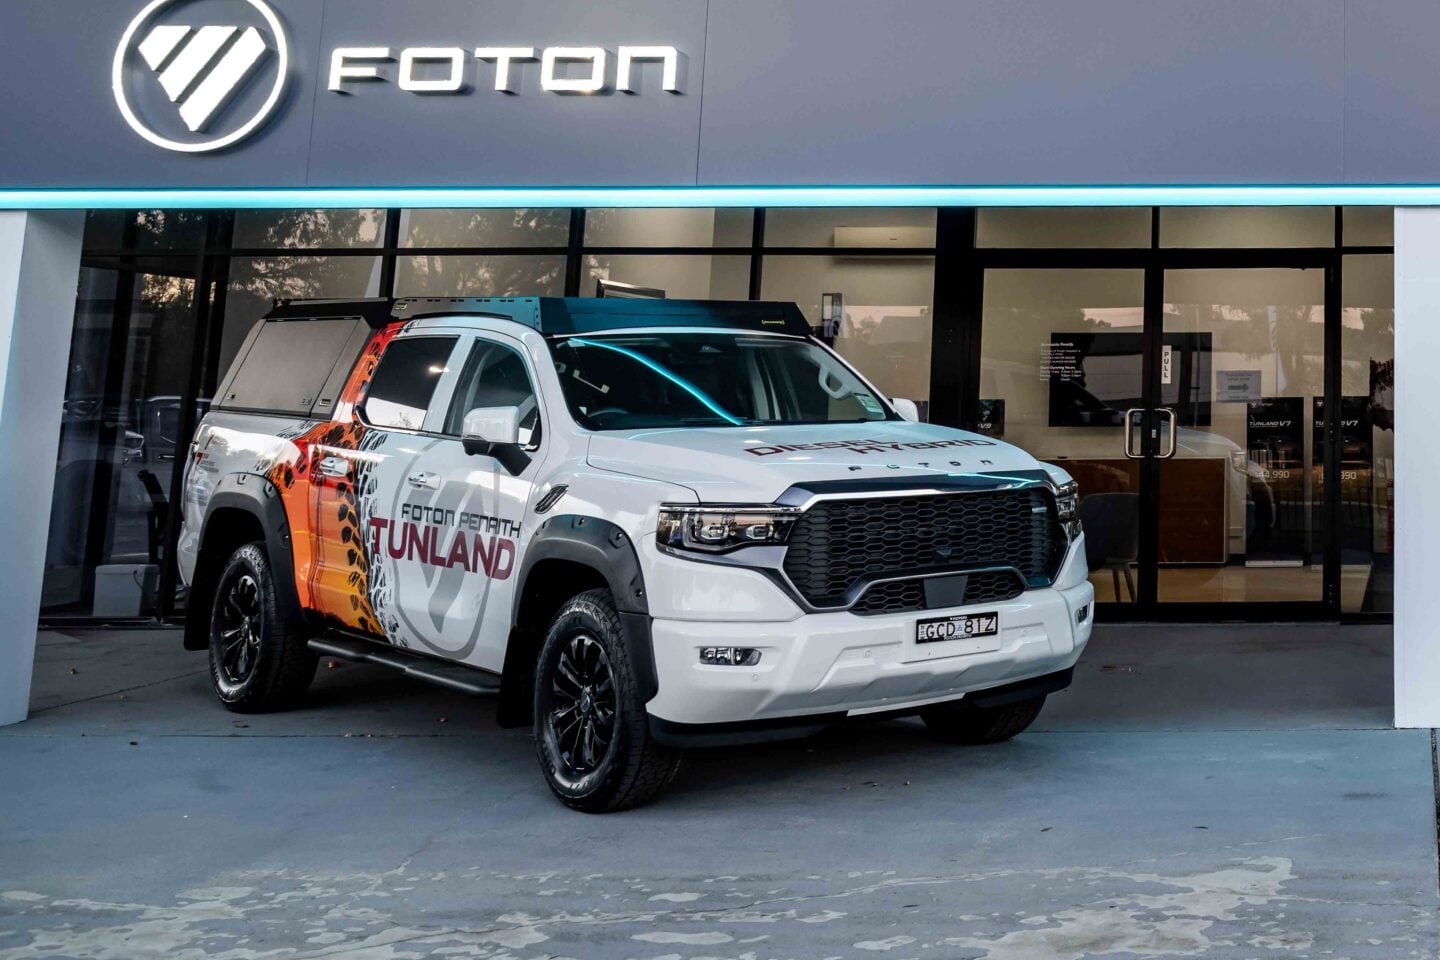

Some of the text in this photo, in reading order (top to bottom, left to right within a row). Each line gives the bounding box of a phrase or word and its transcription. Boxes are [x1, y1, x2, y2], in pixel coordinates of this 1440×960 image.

[328, 46, 680, 92] FOTON
[744, 439, 889, 456] DIESEL
[847, 439, 997, 454] HYBRID
[401, 503, 522, 539] FOTON PENRITH
[370, 516, 516, 581] TUNLAND
[925, 617, 995, 638] GCD 81Z
